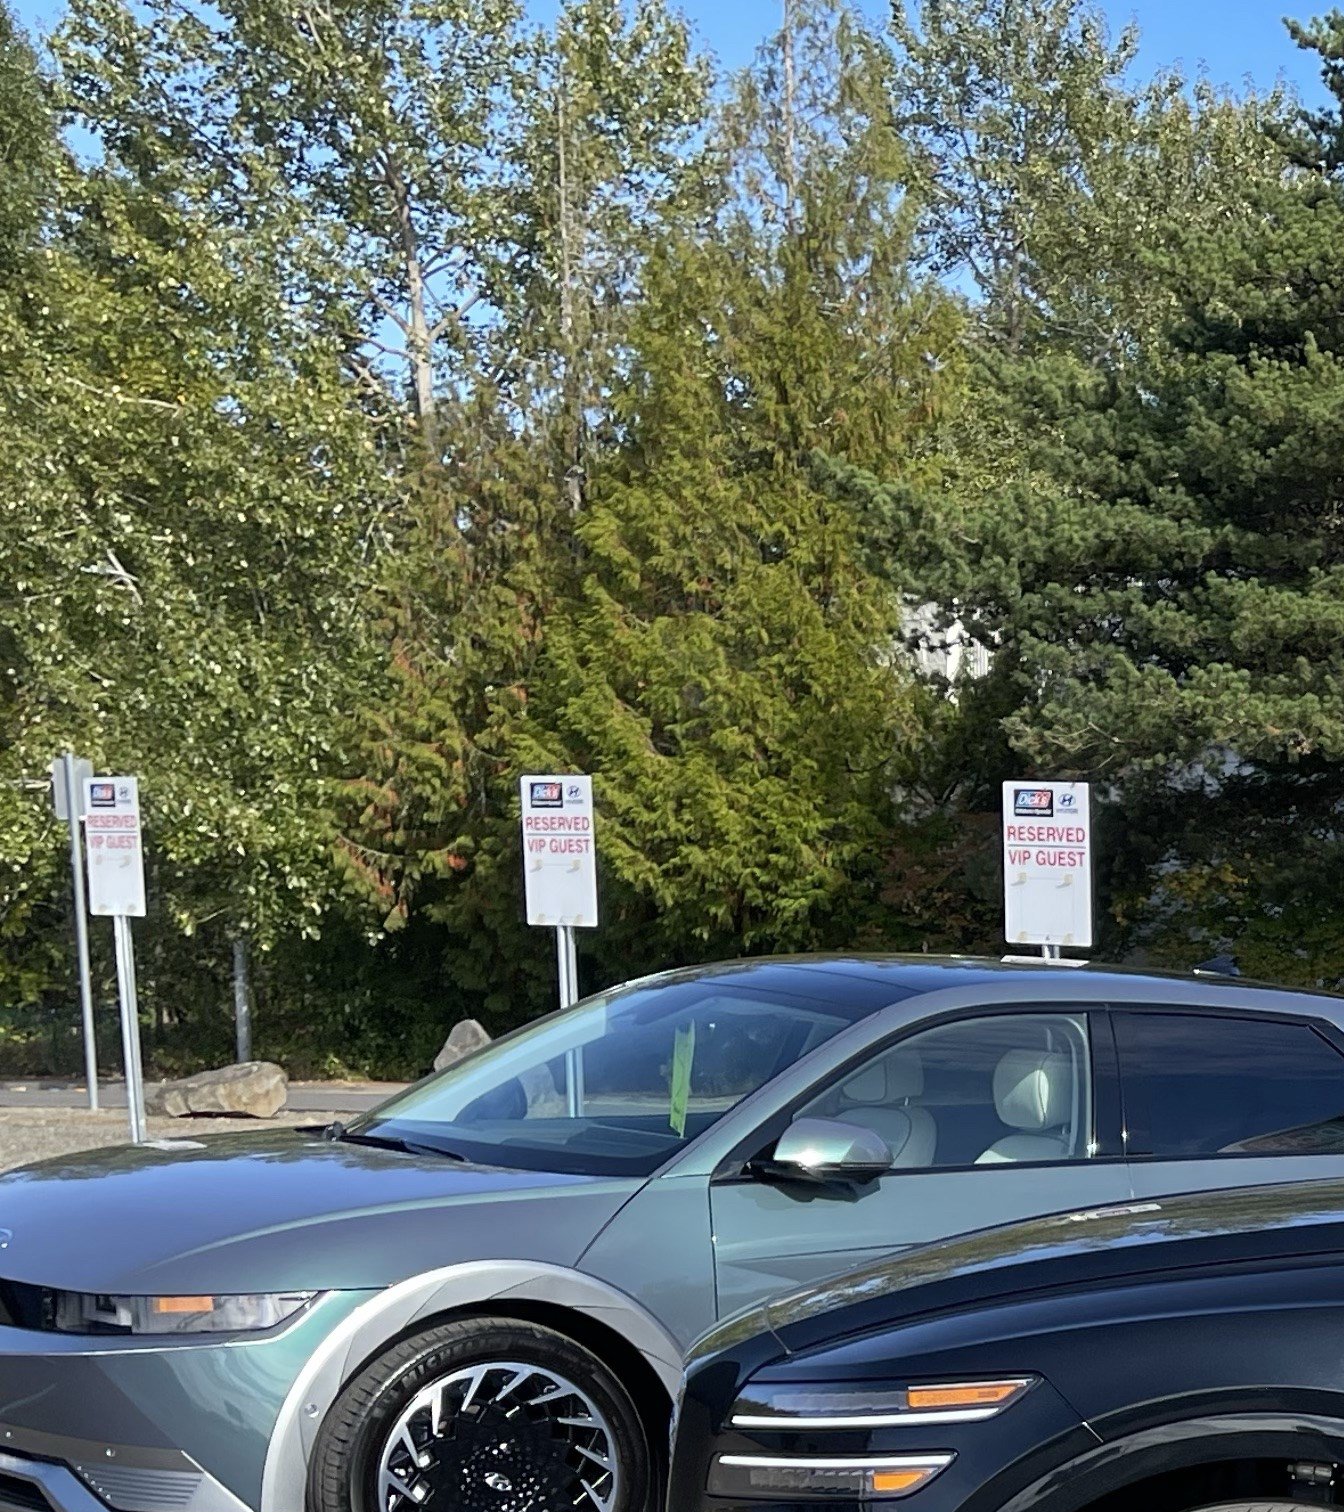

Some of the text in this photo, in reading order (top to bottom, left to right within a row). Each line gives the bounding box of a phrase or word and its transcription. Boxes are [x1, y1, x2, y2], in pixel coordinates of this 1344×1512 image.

[525, 816, 590, 831] RESERVED
[1007, 825, 1086, 843] RESERVED
[527, 838, 590, 854] VIP GUEST
[1008, 849, 1086, 867] VIP GUEST
